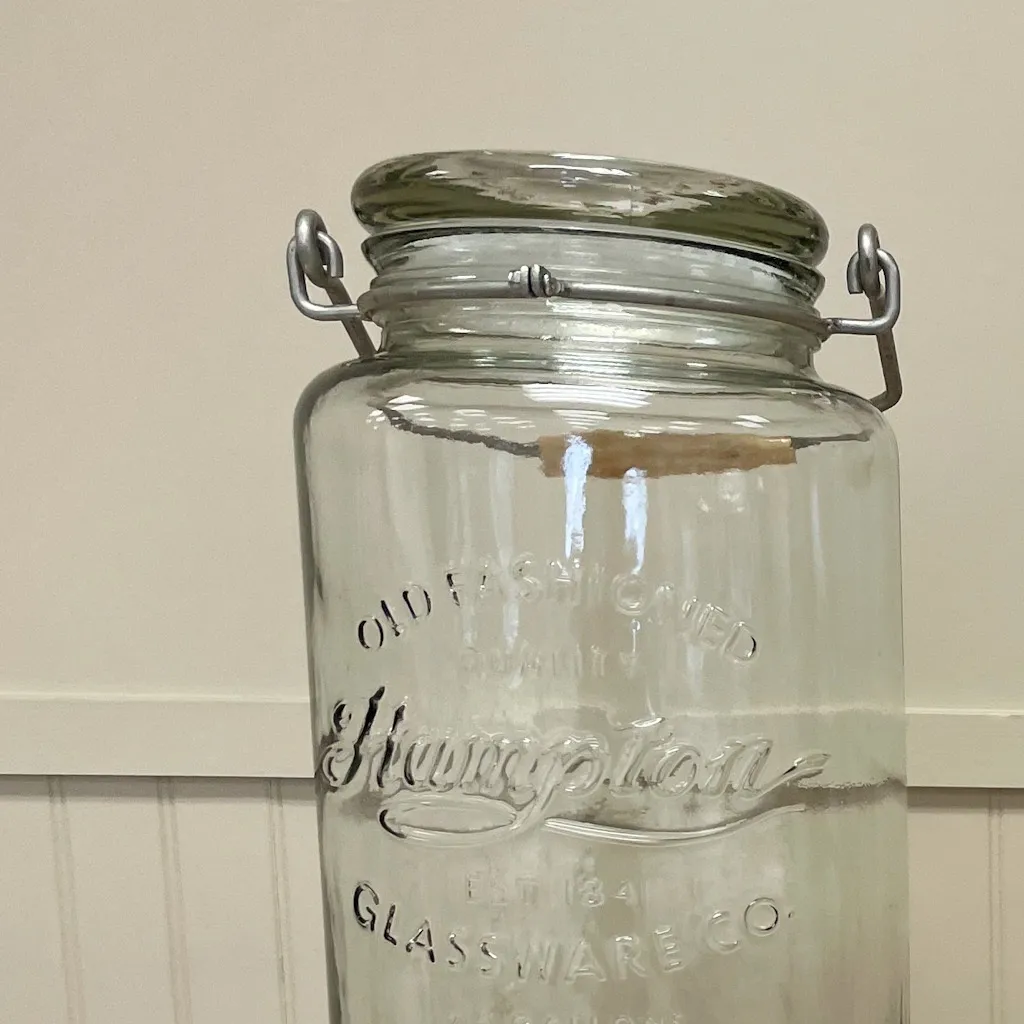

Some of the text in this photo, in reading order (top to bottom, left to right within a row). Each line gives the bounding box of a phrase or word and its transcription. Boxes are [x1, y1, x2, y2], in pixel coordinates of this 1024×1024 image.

[357, 583, 432, 651] OLD
[318, 686, 831, 847] Hampton
[353, 880, 687, 984] GLASSWARE
